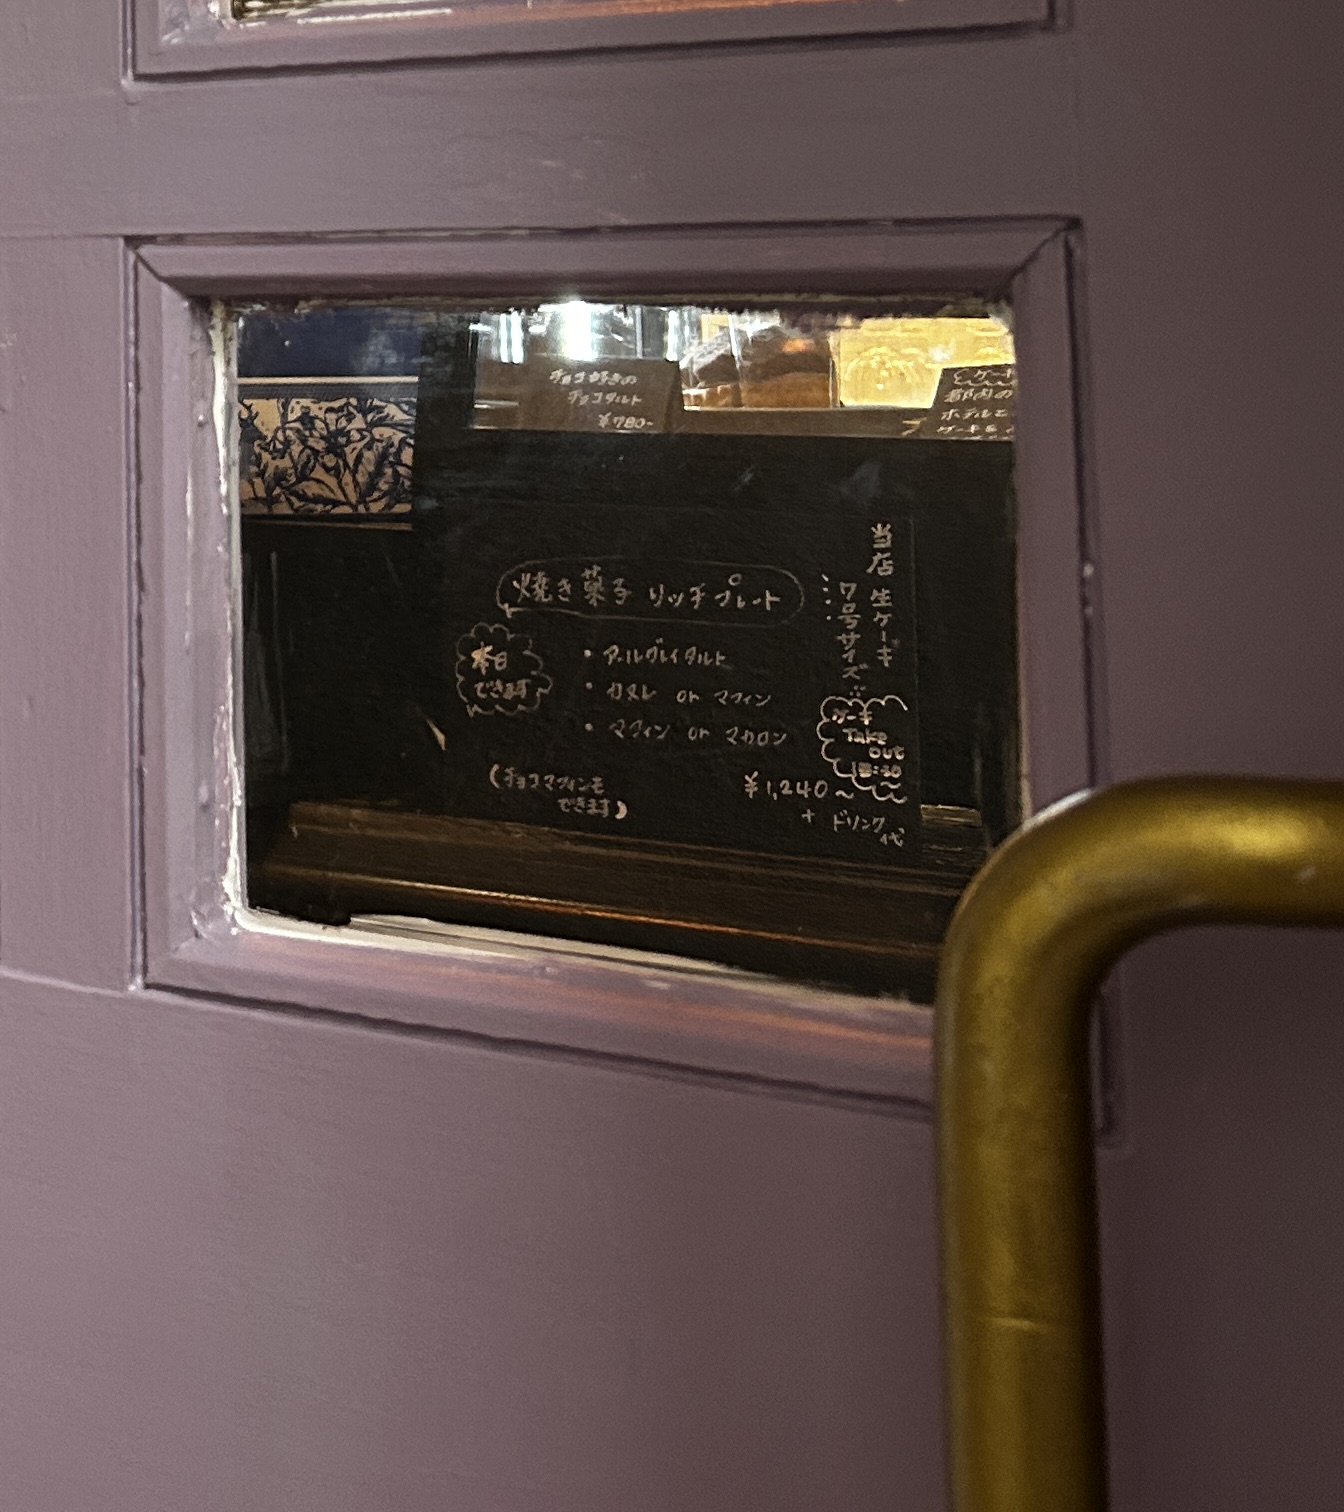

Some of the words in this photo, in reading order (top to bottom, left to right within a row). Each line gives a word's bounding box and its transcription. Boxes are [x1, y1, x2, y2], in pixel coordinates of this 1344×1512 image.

[567, 389, 643, 407] チョコタルト
[865, 522, 894, 577] 当店
[512, 564, 632, 608] 焼き菓子
[649, 573, 782, 611] リッチプレート
[869, 587, 894, 668] 生ケーキ
[470, 641, 508, 676] 本日
[474, 678, 532, 701] できます
[607, 682, 657, 703] カヌレ
[676, 688, 700, 704] or
[688, 724, 710, 741] or
[725, 725, 788, 747] マカロン
[842, 727, 888, 745] Take
